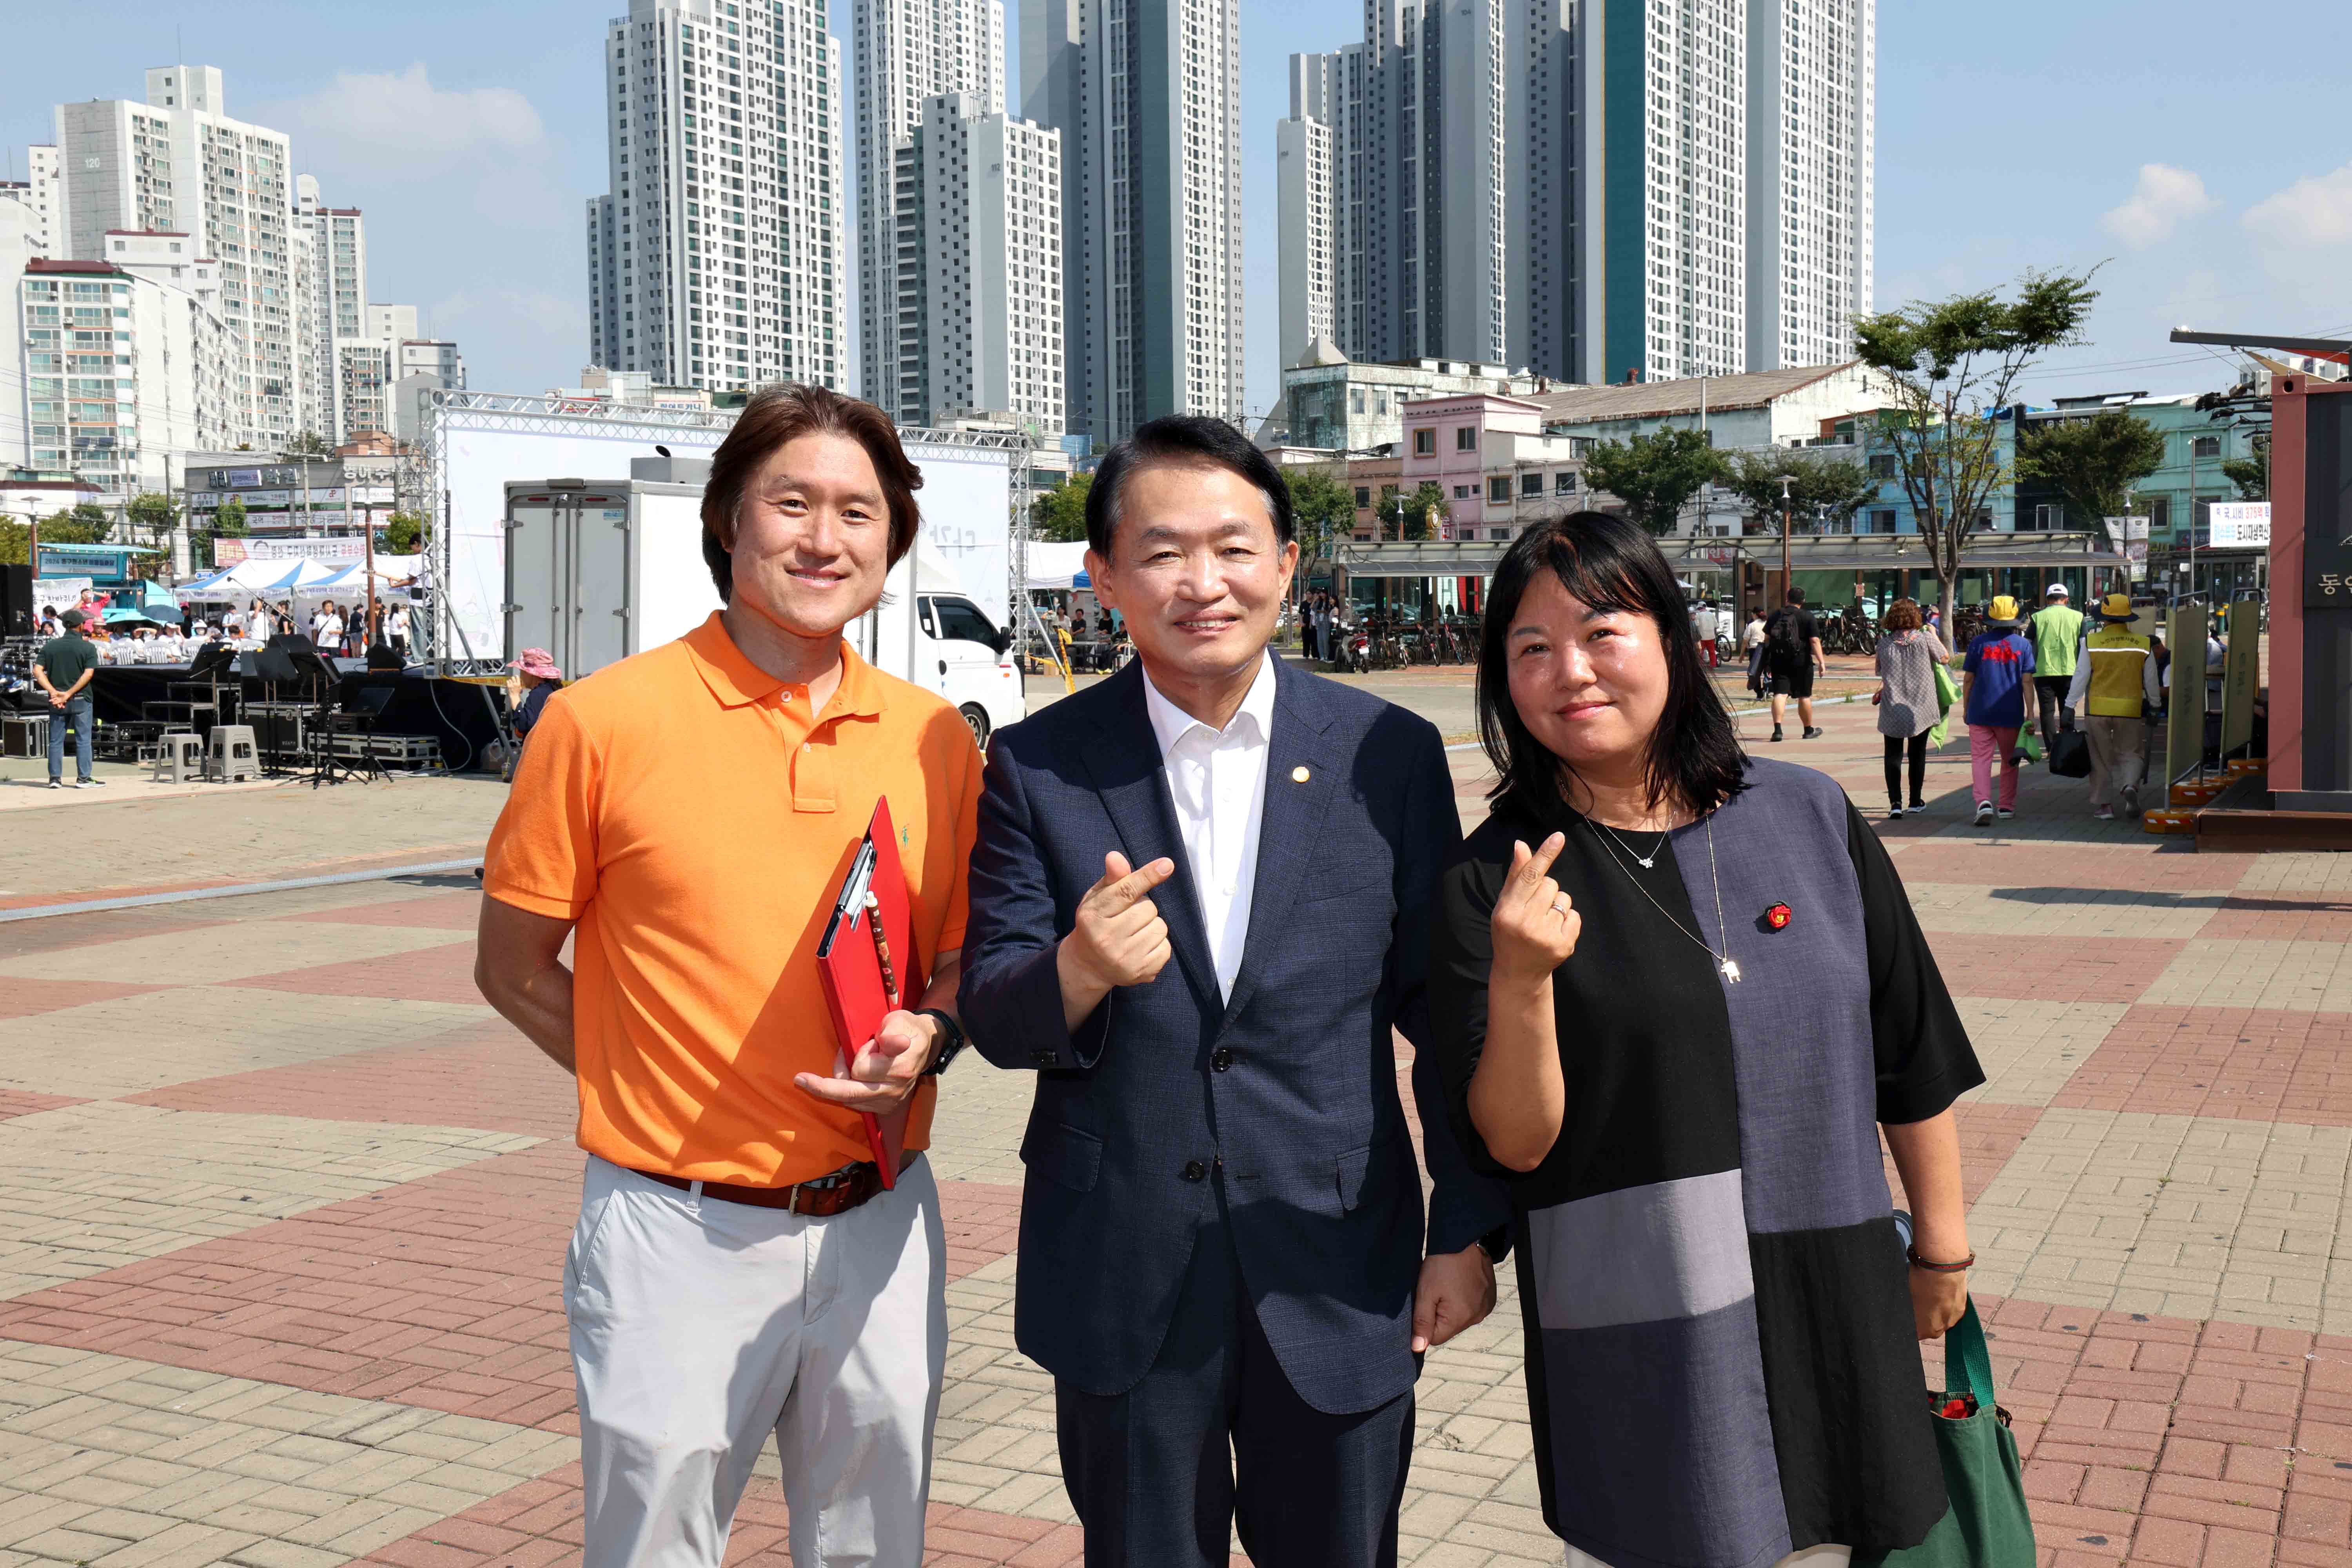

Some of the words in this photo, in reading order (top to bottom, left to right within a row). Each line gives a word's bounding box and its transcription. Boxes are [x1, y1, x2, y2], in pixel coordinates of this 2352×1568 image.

[85, 158, 100, 168] 120
[991, 163, 1000, 172] 112
[343, 465, 372, 479] 영어
[2245, 506, 2263, 519] 375억
[2237, 523, 2271, 542] 도시재생혁신
